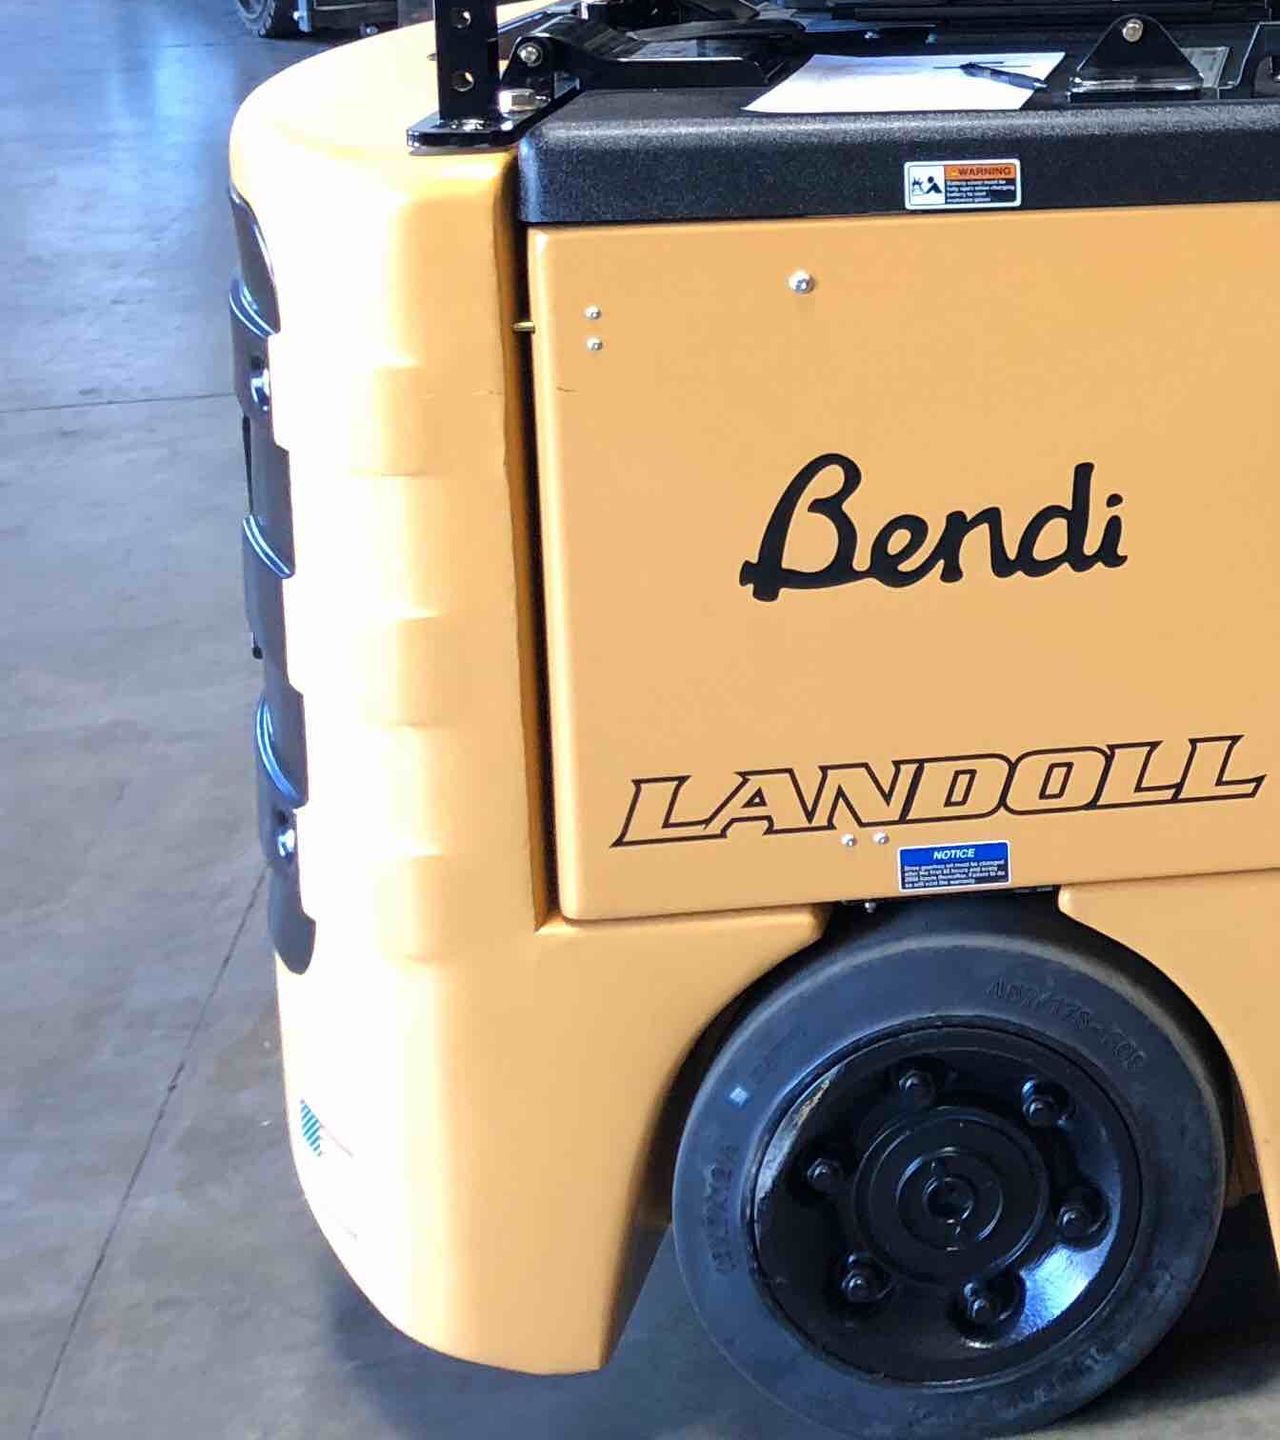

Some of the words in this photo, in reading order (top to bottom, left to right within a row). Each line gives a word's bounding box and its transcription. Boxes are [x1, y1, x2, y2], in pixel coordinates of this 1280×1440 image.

[959, 166, 1012, 176] WARNING
[739, 452, 1128, 603] Bendi
[611, 735, 1267, 847] LANDOLL
[933, 848, 976, 860] NOTICE
